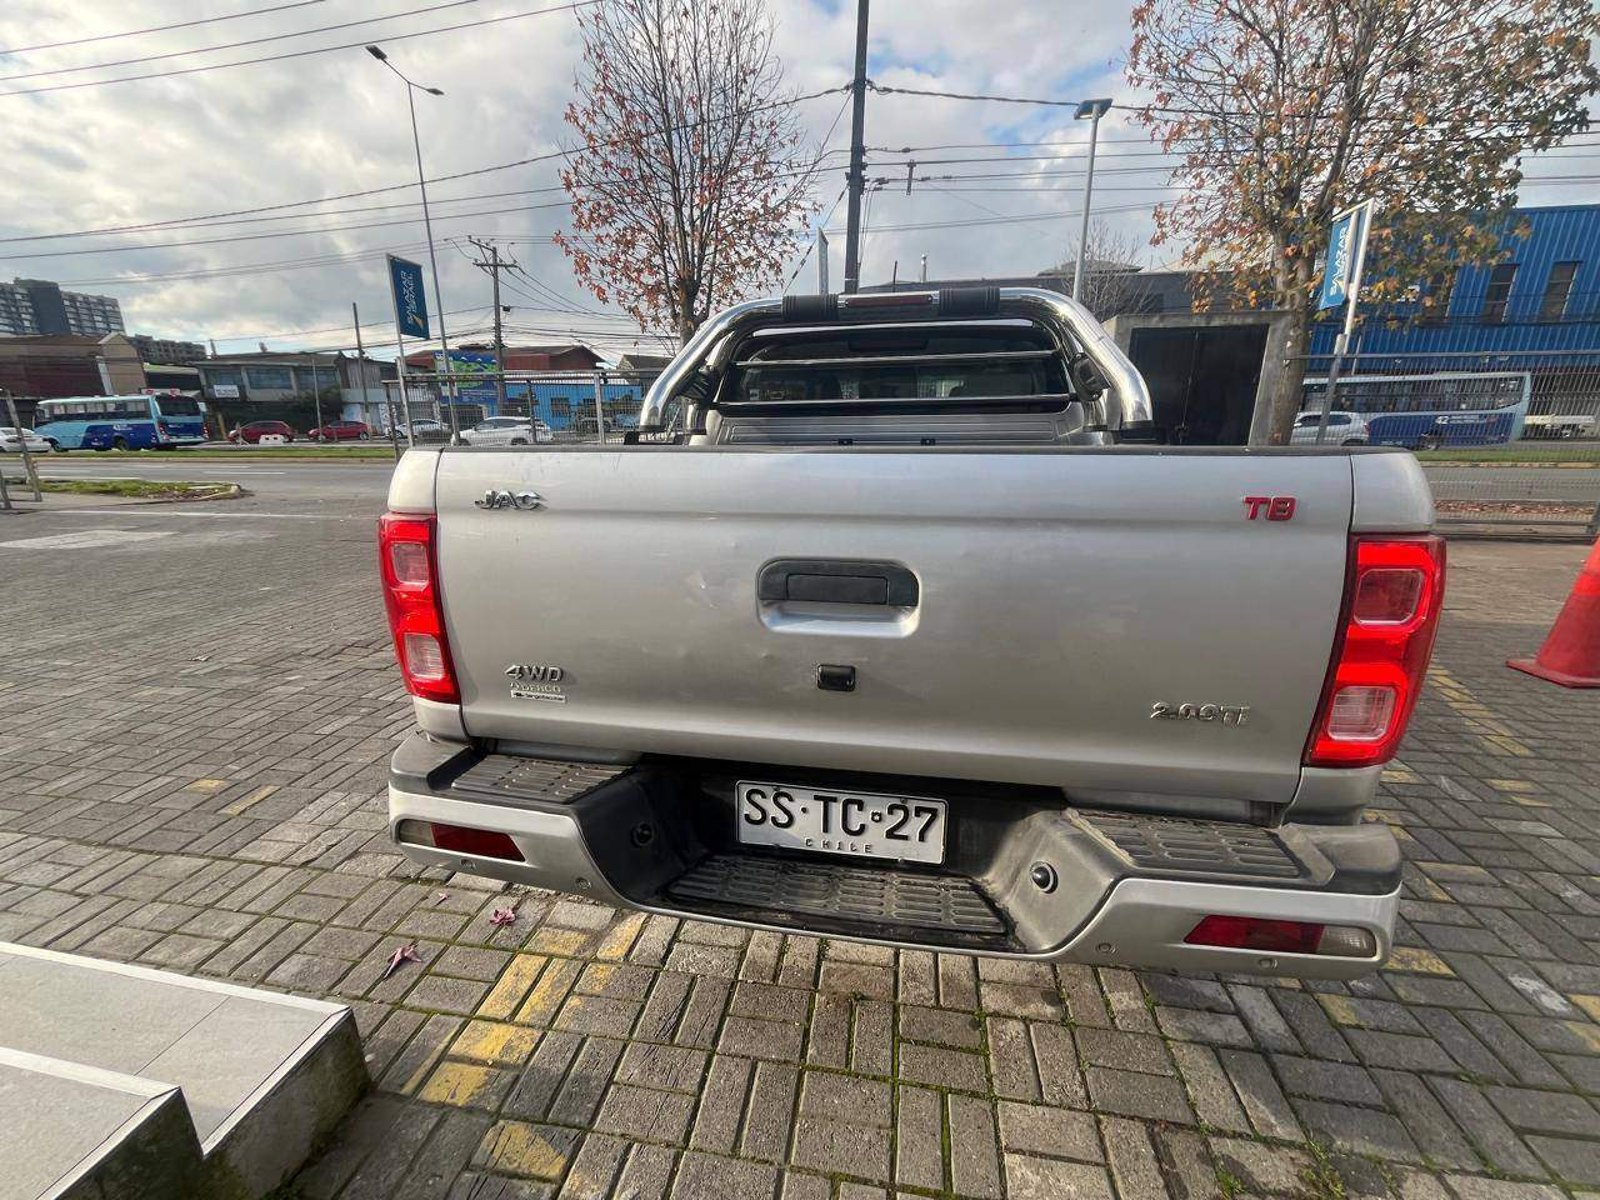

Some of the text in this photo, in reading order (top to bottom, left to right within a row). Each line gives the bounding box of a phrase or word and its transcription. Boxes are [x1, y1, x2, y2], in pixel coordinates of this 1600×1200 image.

[474, 490, 541, 510] JAC
[504, 664, 563, 681] 4WD
[805, 838, 872, 853] CHILE
